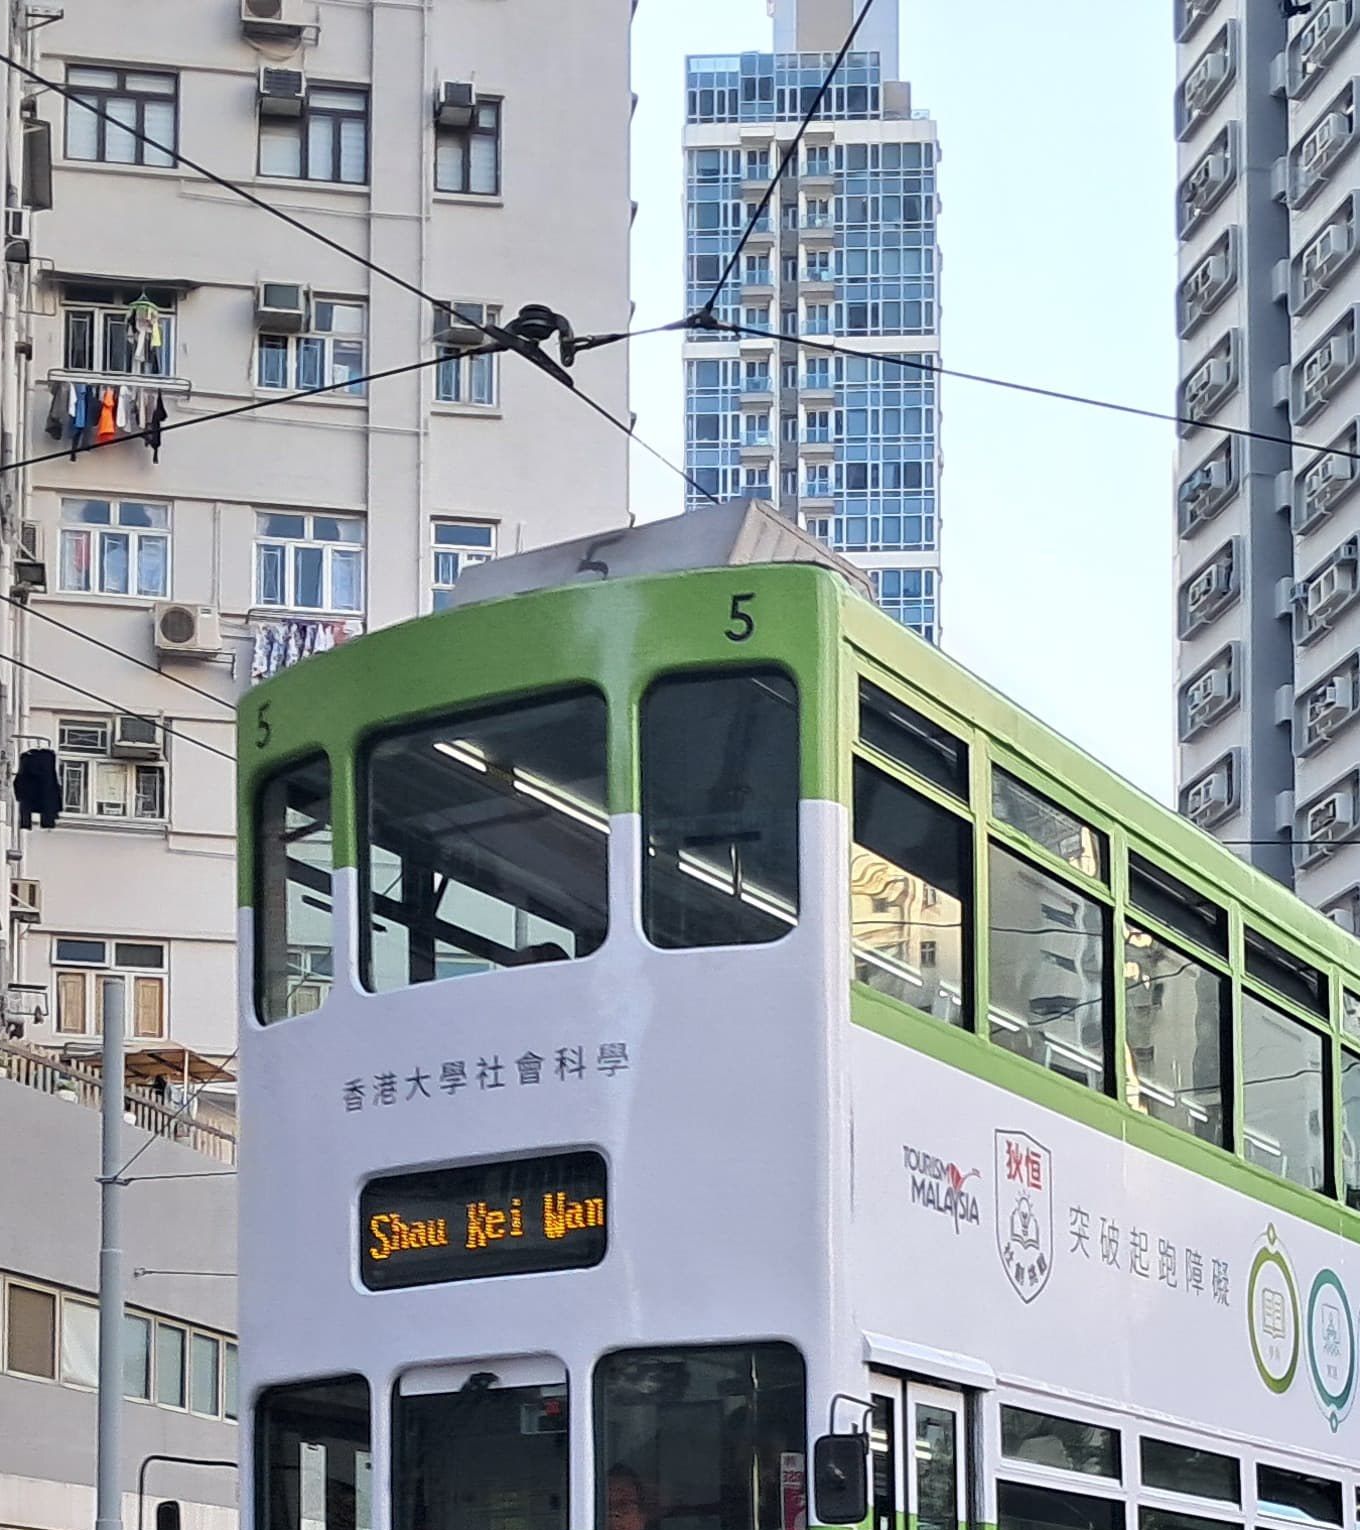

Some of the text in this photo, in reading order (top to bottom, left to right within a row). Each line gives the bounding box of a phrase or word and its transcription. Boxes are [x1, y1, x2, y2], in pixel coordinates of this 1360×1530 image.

[723, 592, 756, 641] 5
[256, 702, 272, 749] 5
[342, 1042, 630, 1112] 香港大學社會科學
[903, 1145, 949, 1181] TOURISM
[1006, 1139, 1042, 1191] 狄恒
[369, 1192, 605, 1260] Shau Kei Wan
[911, 1174, 981, 1235] MALAYSIA
[1069, 1205, 1229, 1307] 突破起跑障礙
